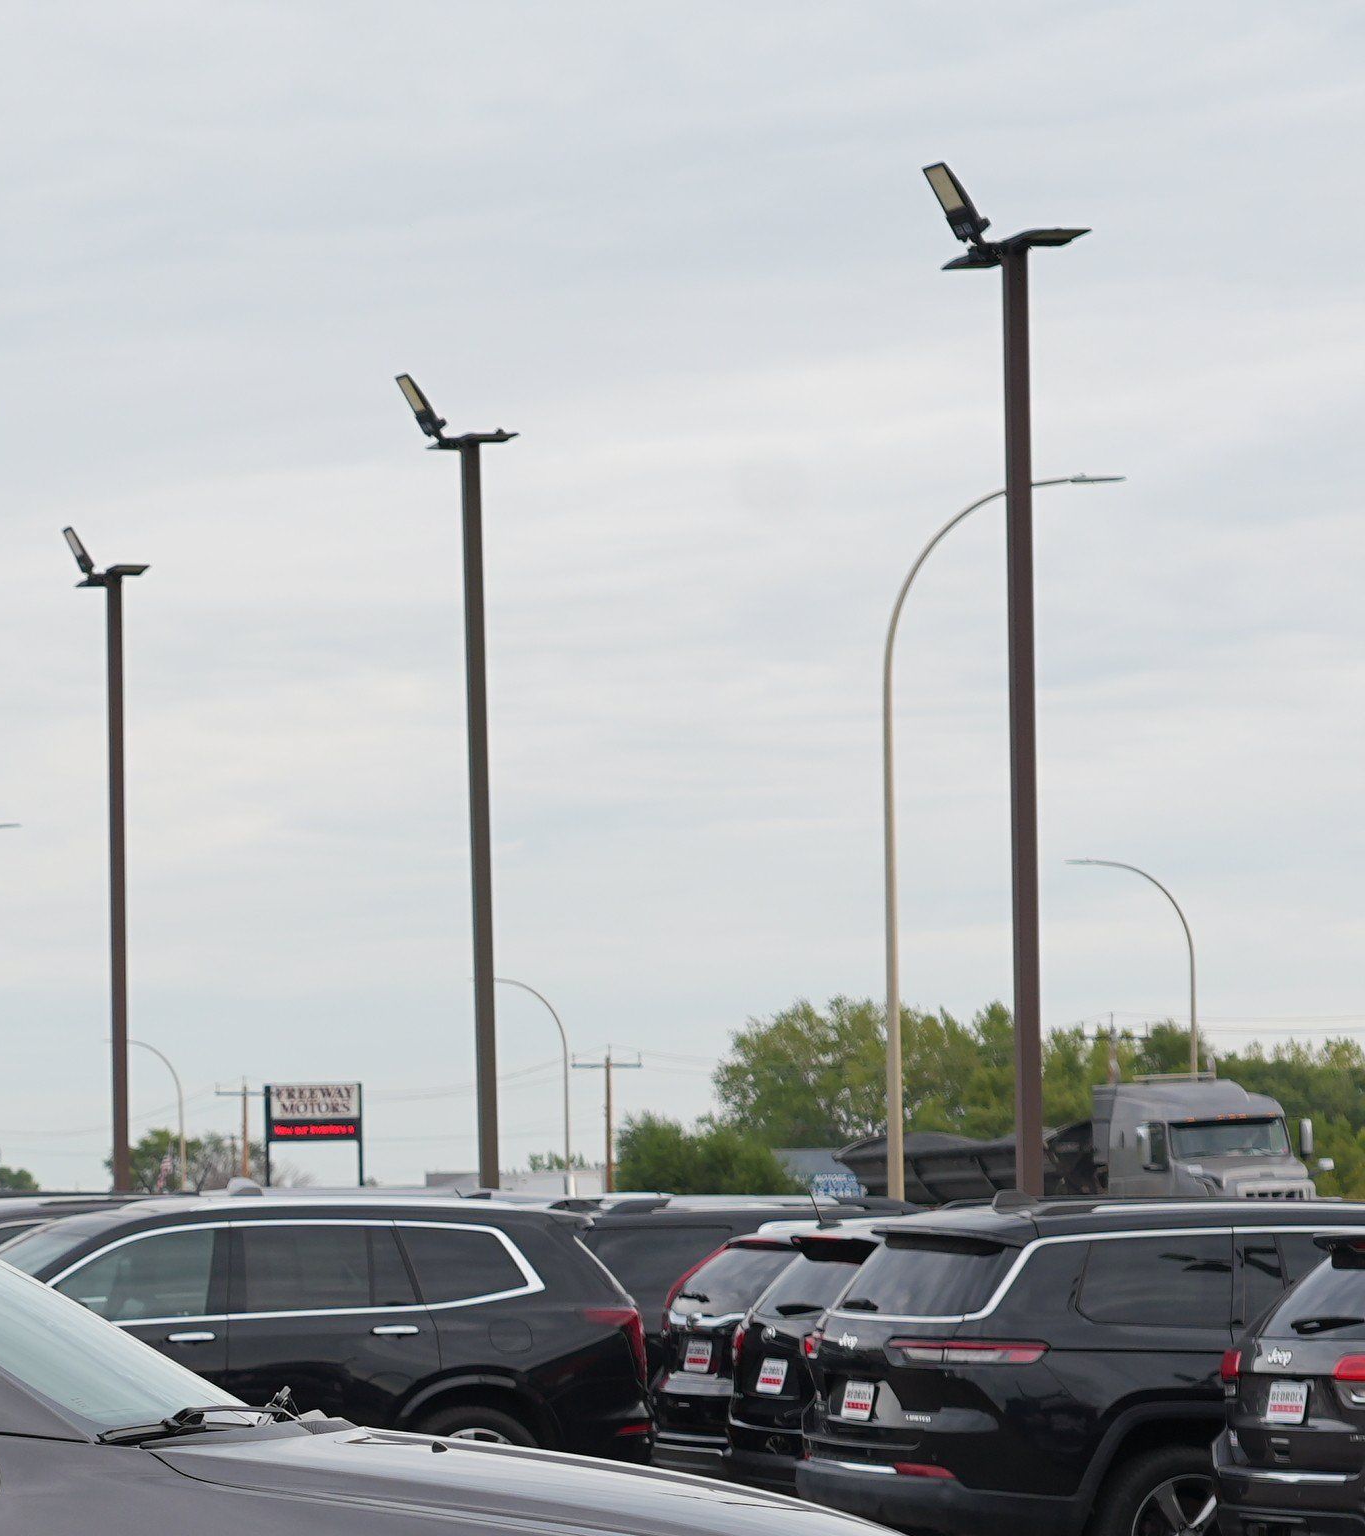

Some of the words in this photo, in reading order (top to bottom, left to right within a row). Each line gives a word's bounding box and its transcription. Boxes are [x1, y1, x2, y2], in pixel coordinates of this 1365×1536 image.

[275, 1087, 354, 1100] FREEWAY
[281, 1101, 351, 1113] MOTORS
[838, 1332, 858, 1350] Jeep
[1267, 1346, 1292, 1367] Jeep
